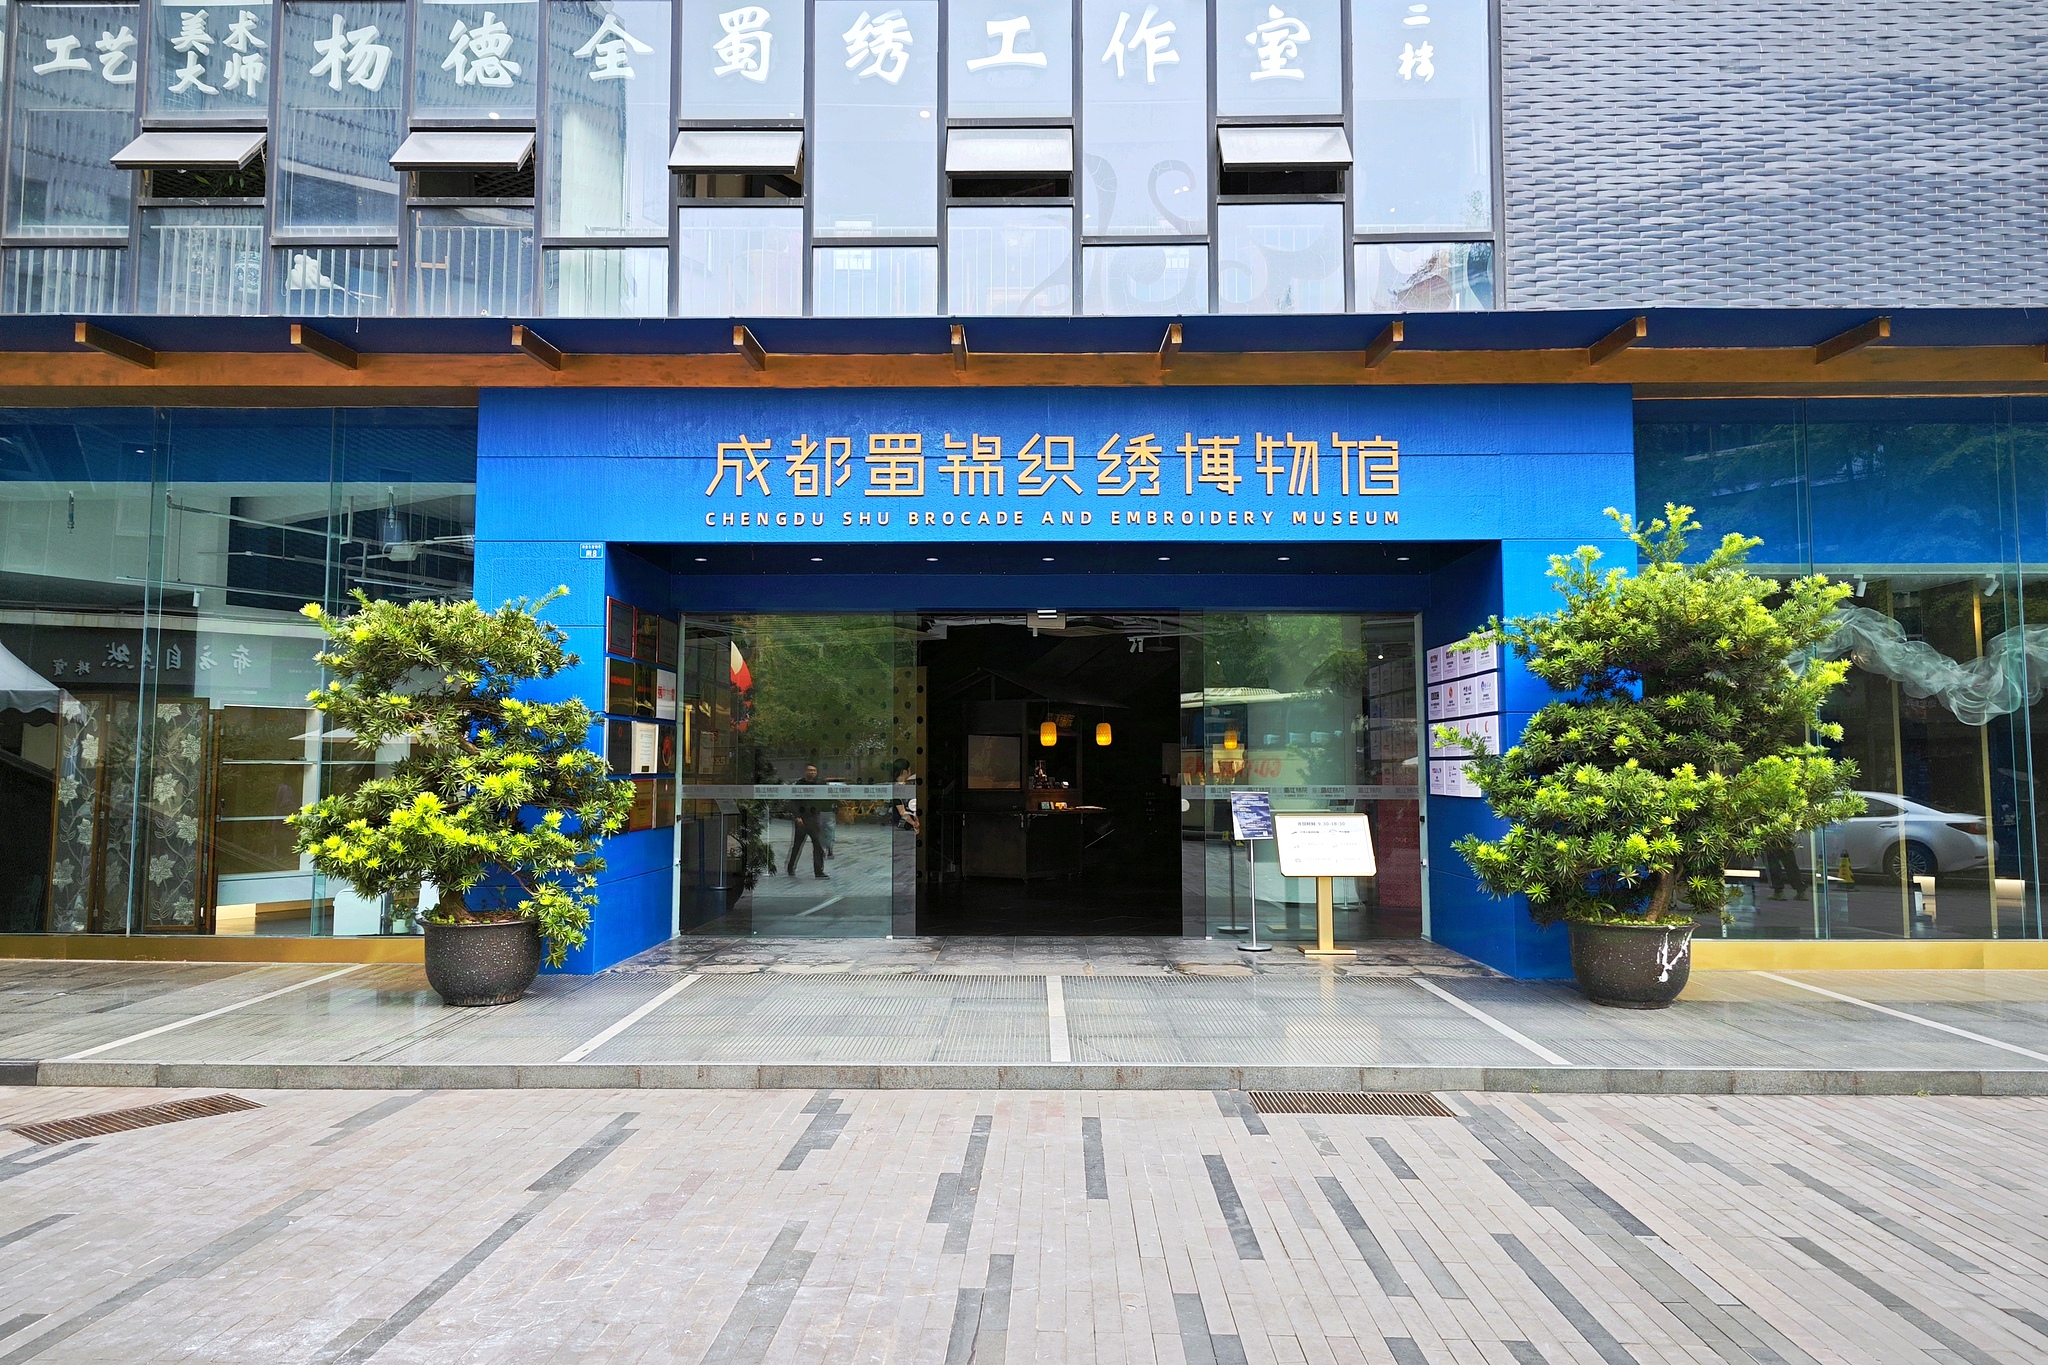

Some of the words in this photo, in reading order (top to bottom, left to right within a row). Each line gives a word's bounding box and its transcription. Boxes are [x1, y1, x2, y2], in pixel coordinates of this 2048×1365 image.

[33, 26, 138, 84] 工艺
[170, 9, 269, 56] 美术
[168, 51, 268, 98] 大师
[704, 431, 1401, 498] 成都蜀锦织绣博物馆
[704, 511, 825, 527] CHENGDU
[842, 511, 891, 526] SHU
[907, 511, 1024, 526] BROCADE
[1041, 510, 1093, 526] AND
[1110, 510, 1275, 526] EMBROIDERY
[1292, 510, 1400, 525] MUSEUM
